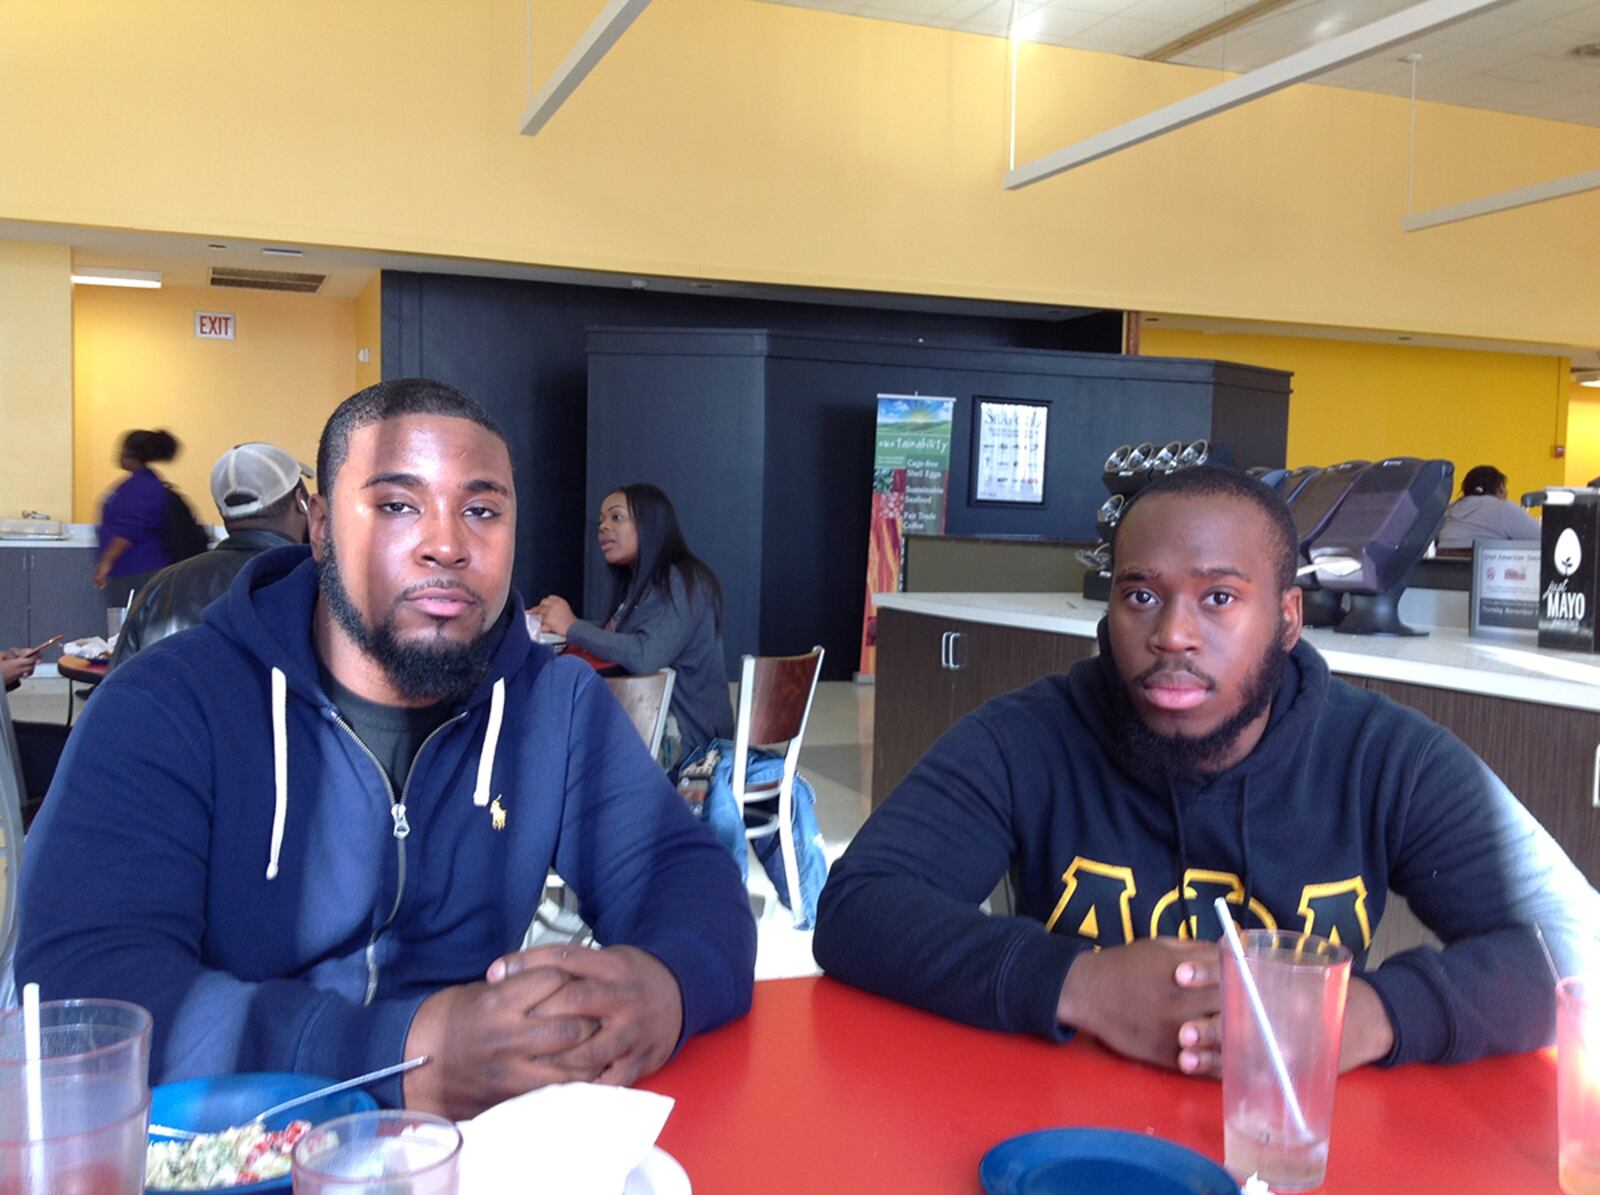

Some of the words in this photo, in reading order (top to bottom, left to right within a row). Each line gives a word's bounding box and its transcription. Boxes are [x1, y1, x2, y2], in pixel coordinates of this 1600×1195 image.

[200, 315, 231, 335] EXIT
[1542, 578, 1569, 601] just
[1546, 592, 1586, 621] MAYO
